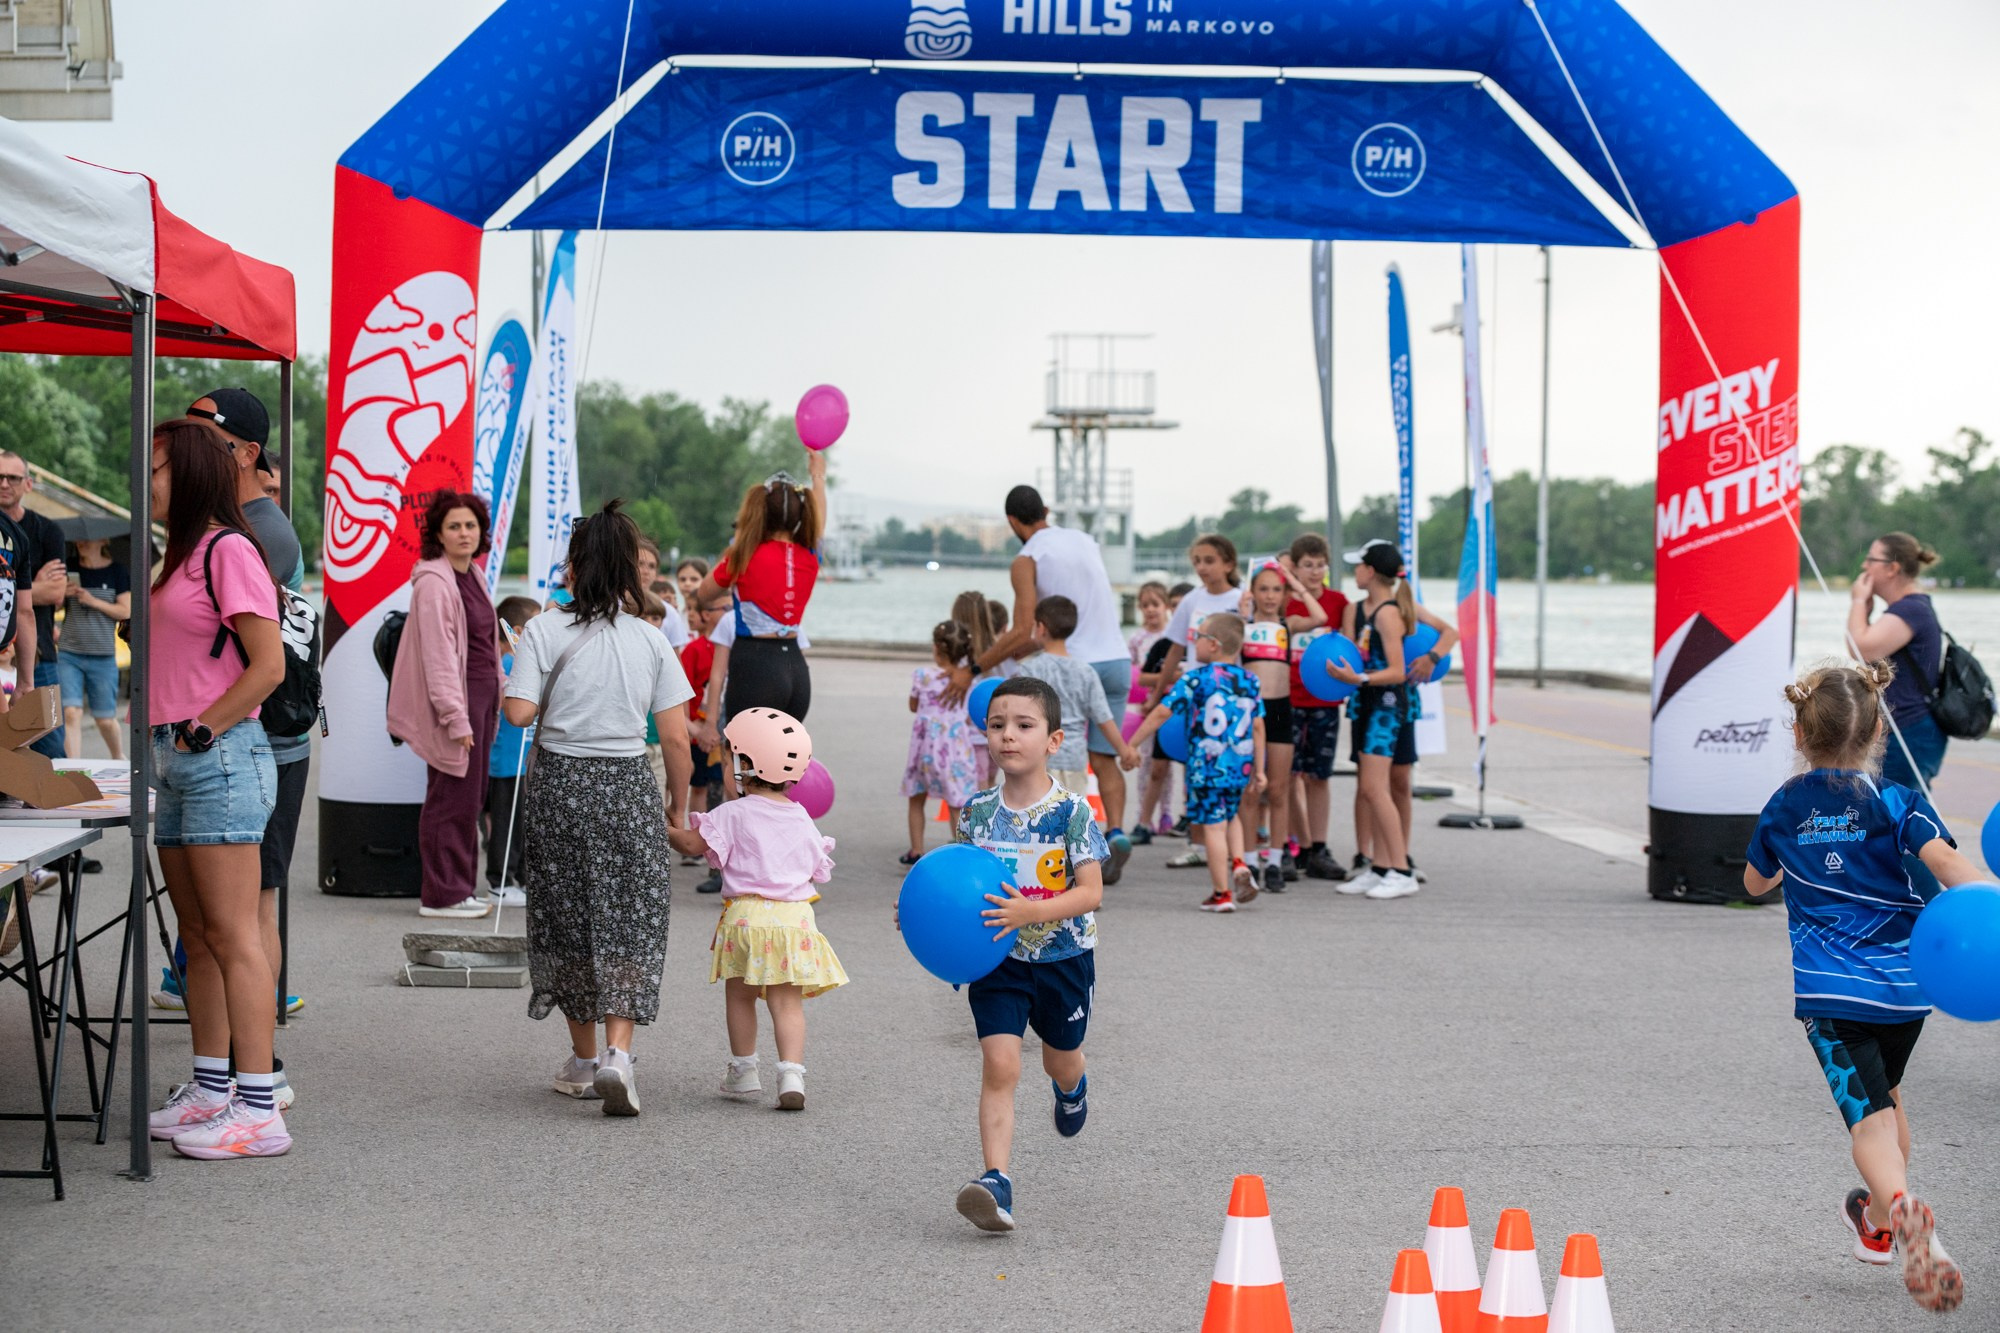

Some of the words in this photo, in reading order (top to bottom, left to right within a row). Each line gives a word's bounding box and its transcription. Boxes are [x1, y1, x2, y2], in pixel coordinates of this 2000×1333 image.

[1003, 0, 1132, 36] HILLS
[1147, 0, 1173, 13] IN
[1146, 19, 1275, 35] MARKOVO
[734, 135, 782, 159] P/H
[892, 91, 1262, 214] START
[1365, 146, 1413, 170] P/H
[1658, 358, 1781, 452] EVERY
[1656, 446, 1801, 549] MATTER
[1250, 629, 1267, 642] 61
[1203, 692, 1257, 737] 67
[1694, 718, 1773, 753] petroff
[1813, 815, 1849, 828] TEAM
